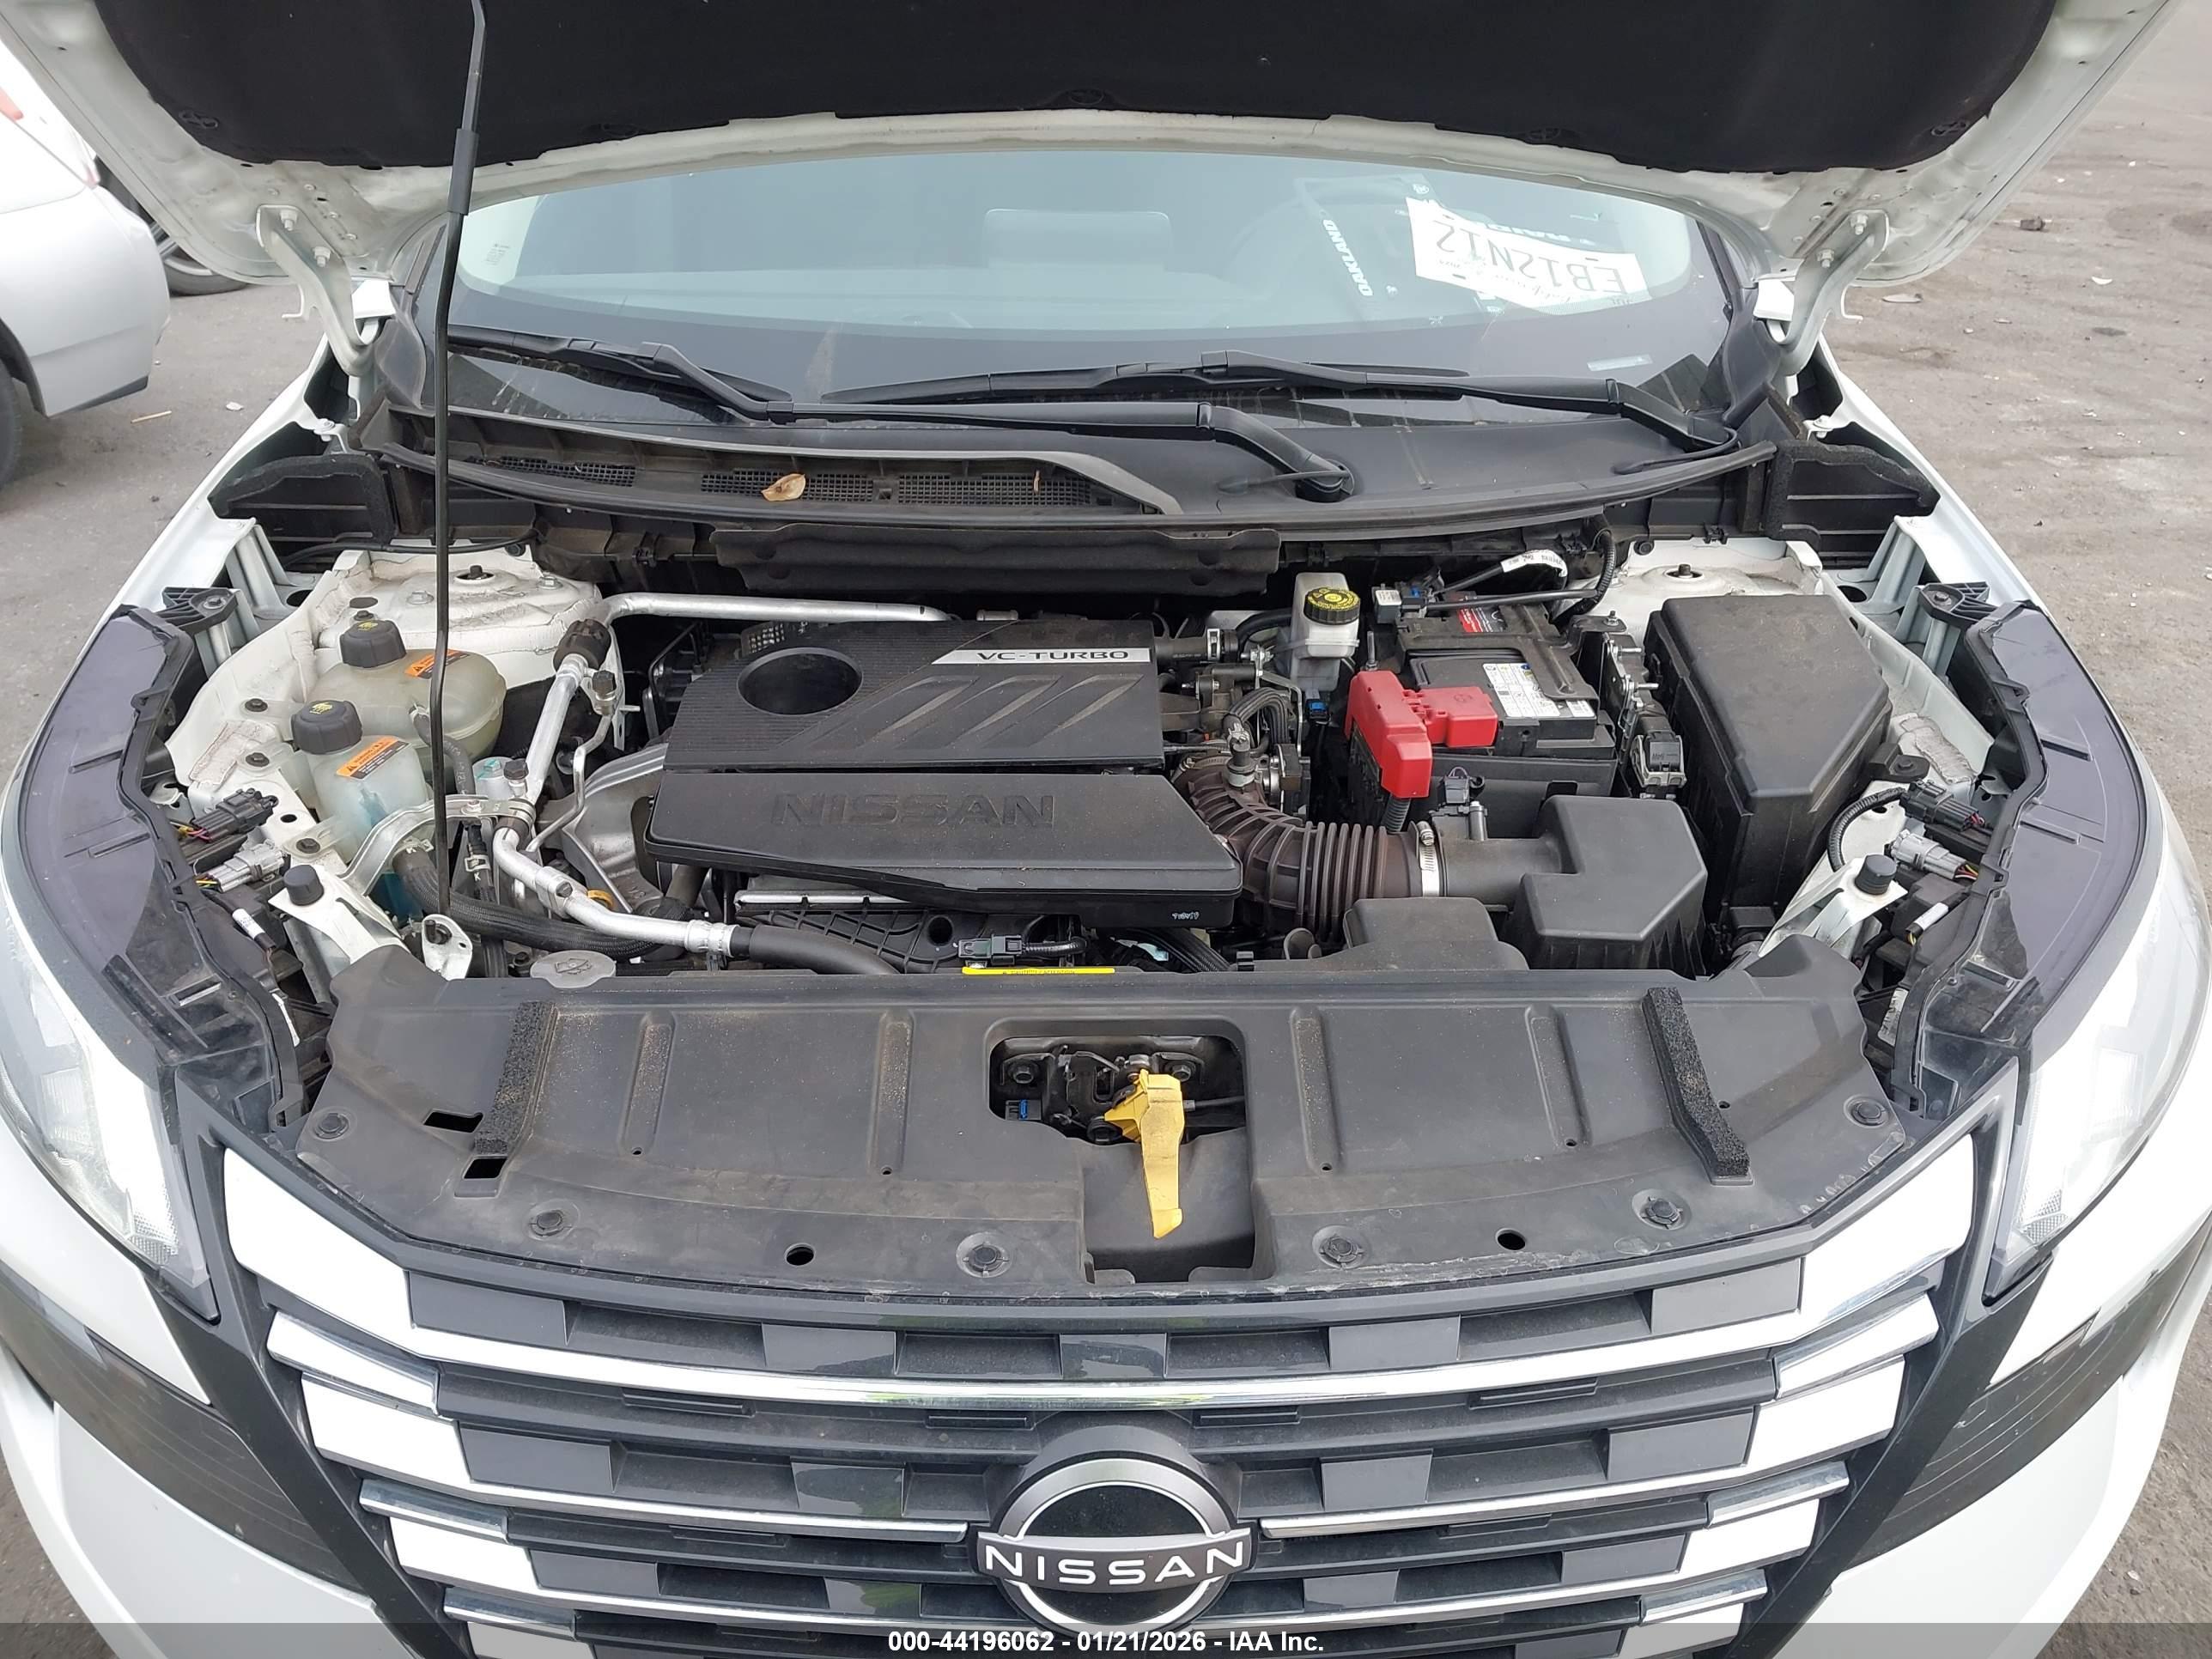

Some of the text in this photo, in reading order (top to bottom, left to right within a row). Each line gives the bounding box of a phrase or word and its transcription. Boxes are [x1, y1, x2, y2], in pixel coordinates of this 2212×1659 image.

[1322, 219, 1374, 297] OAKLAND
[1432, 220, 1627, 295] EB12N12
[976, 650, 1129, 661] VC-TURBO
[771, 793, 1057, 827] NISSAN
[984, 1540, 1244, 1585] NISSAN
